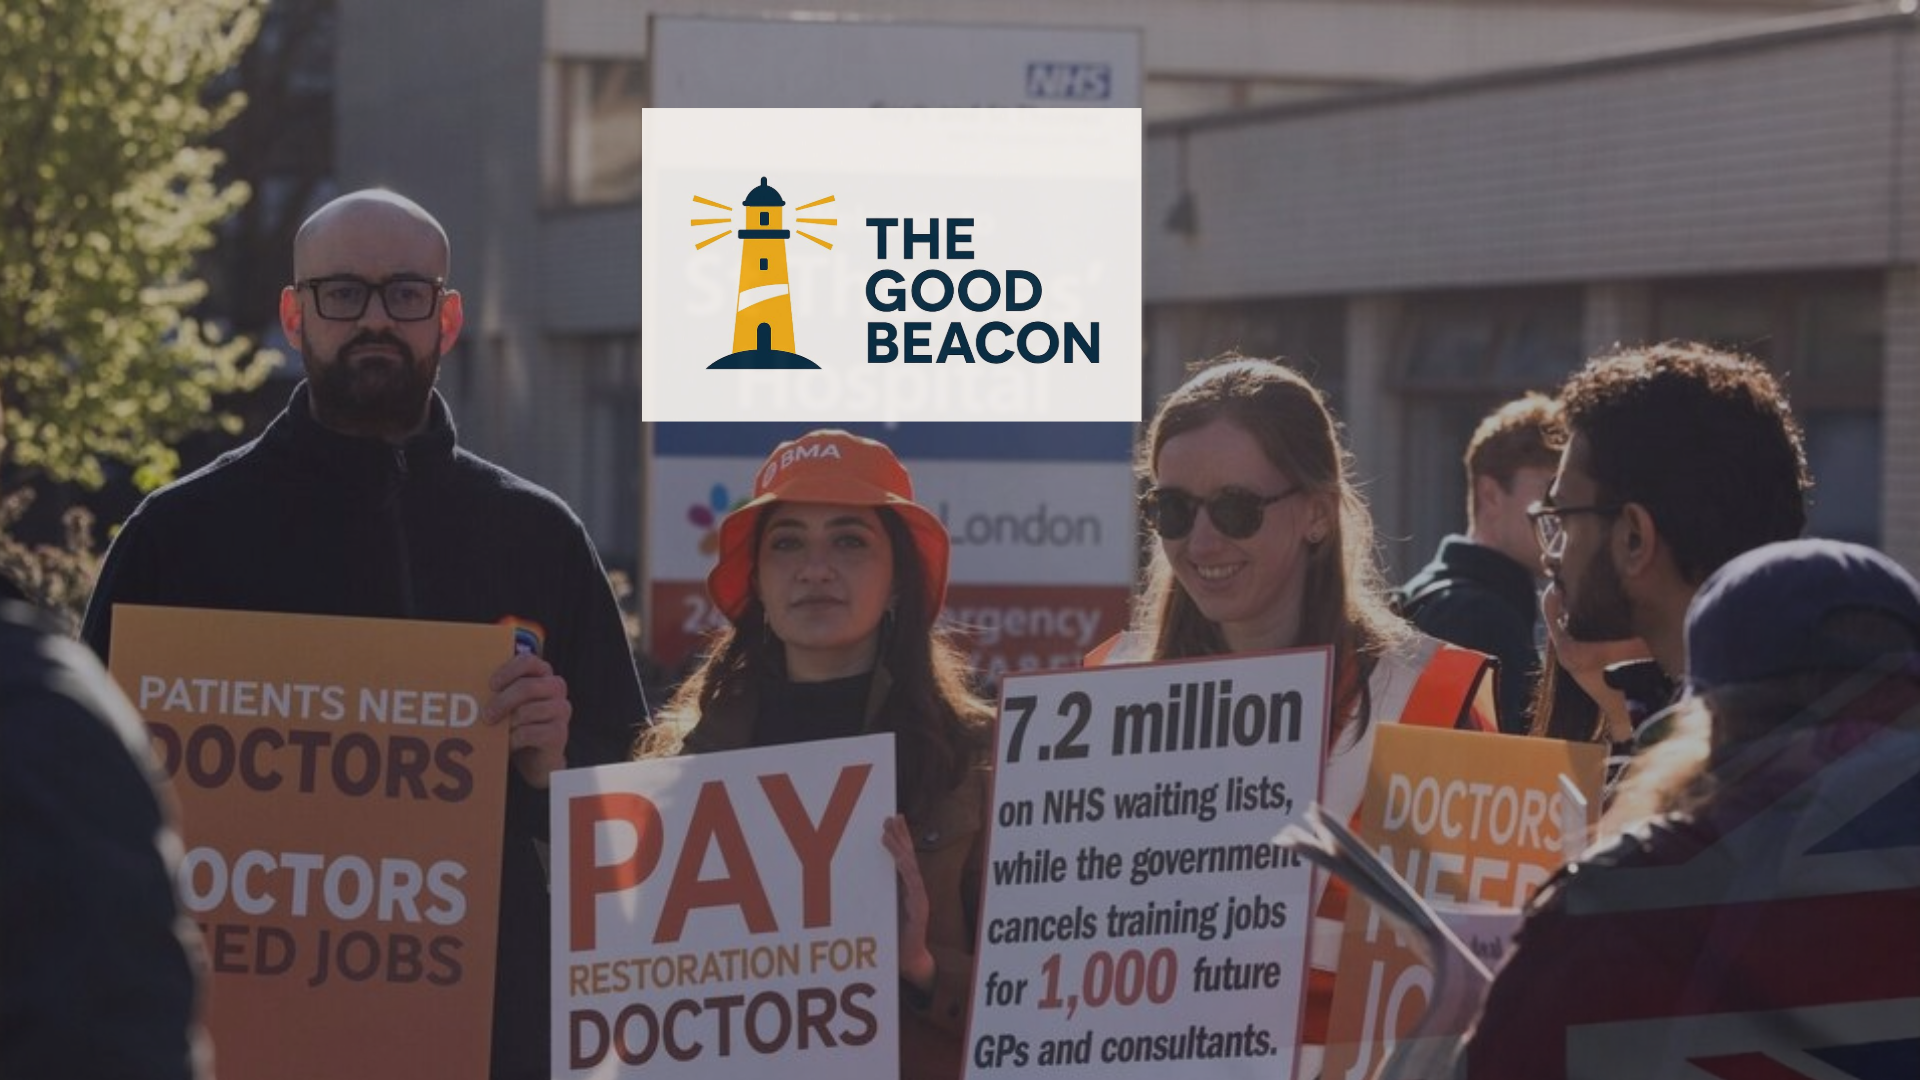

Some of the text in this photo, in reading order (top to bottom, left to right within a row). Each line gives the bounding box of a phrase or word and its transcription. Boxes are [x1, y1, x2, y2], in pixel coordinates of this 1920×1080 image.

[1030, 64, 1105, 97] NHS
[780, 443, 841, 470] BMA
[942, 502, 1101, 547] London
[139, 676, 479, 729] PATIENTS NEED
[1004, 679, 1303, 763] 7.2 million
[999, 776, 1294, 828] on NHS waiting lists,
[1383, 773, 1563, 852] DOCTORS
[179, 846, 468, 926] OCTORS
[568, 764, 874, 952] PAY
[993, 849, 1067, 886] while
[1076, 846, 1122, 881] the
[987, 895, 1287, 944] cancels training jobs
[308, 929, 464, 988] JOBS
[569, 936, 878, 997] RESTORATION FOR
[985, 947, 1281, 1021] for 1,000 future
[569, 982, 878, 1070] DOCTORS
[974, 1022, 1278, 1069] GPs and consultants.
